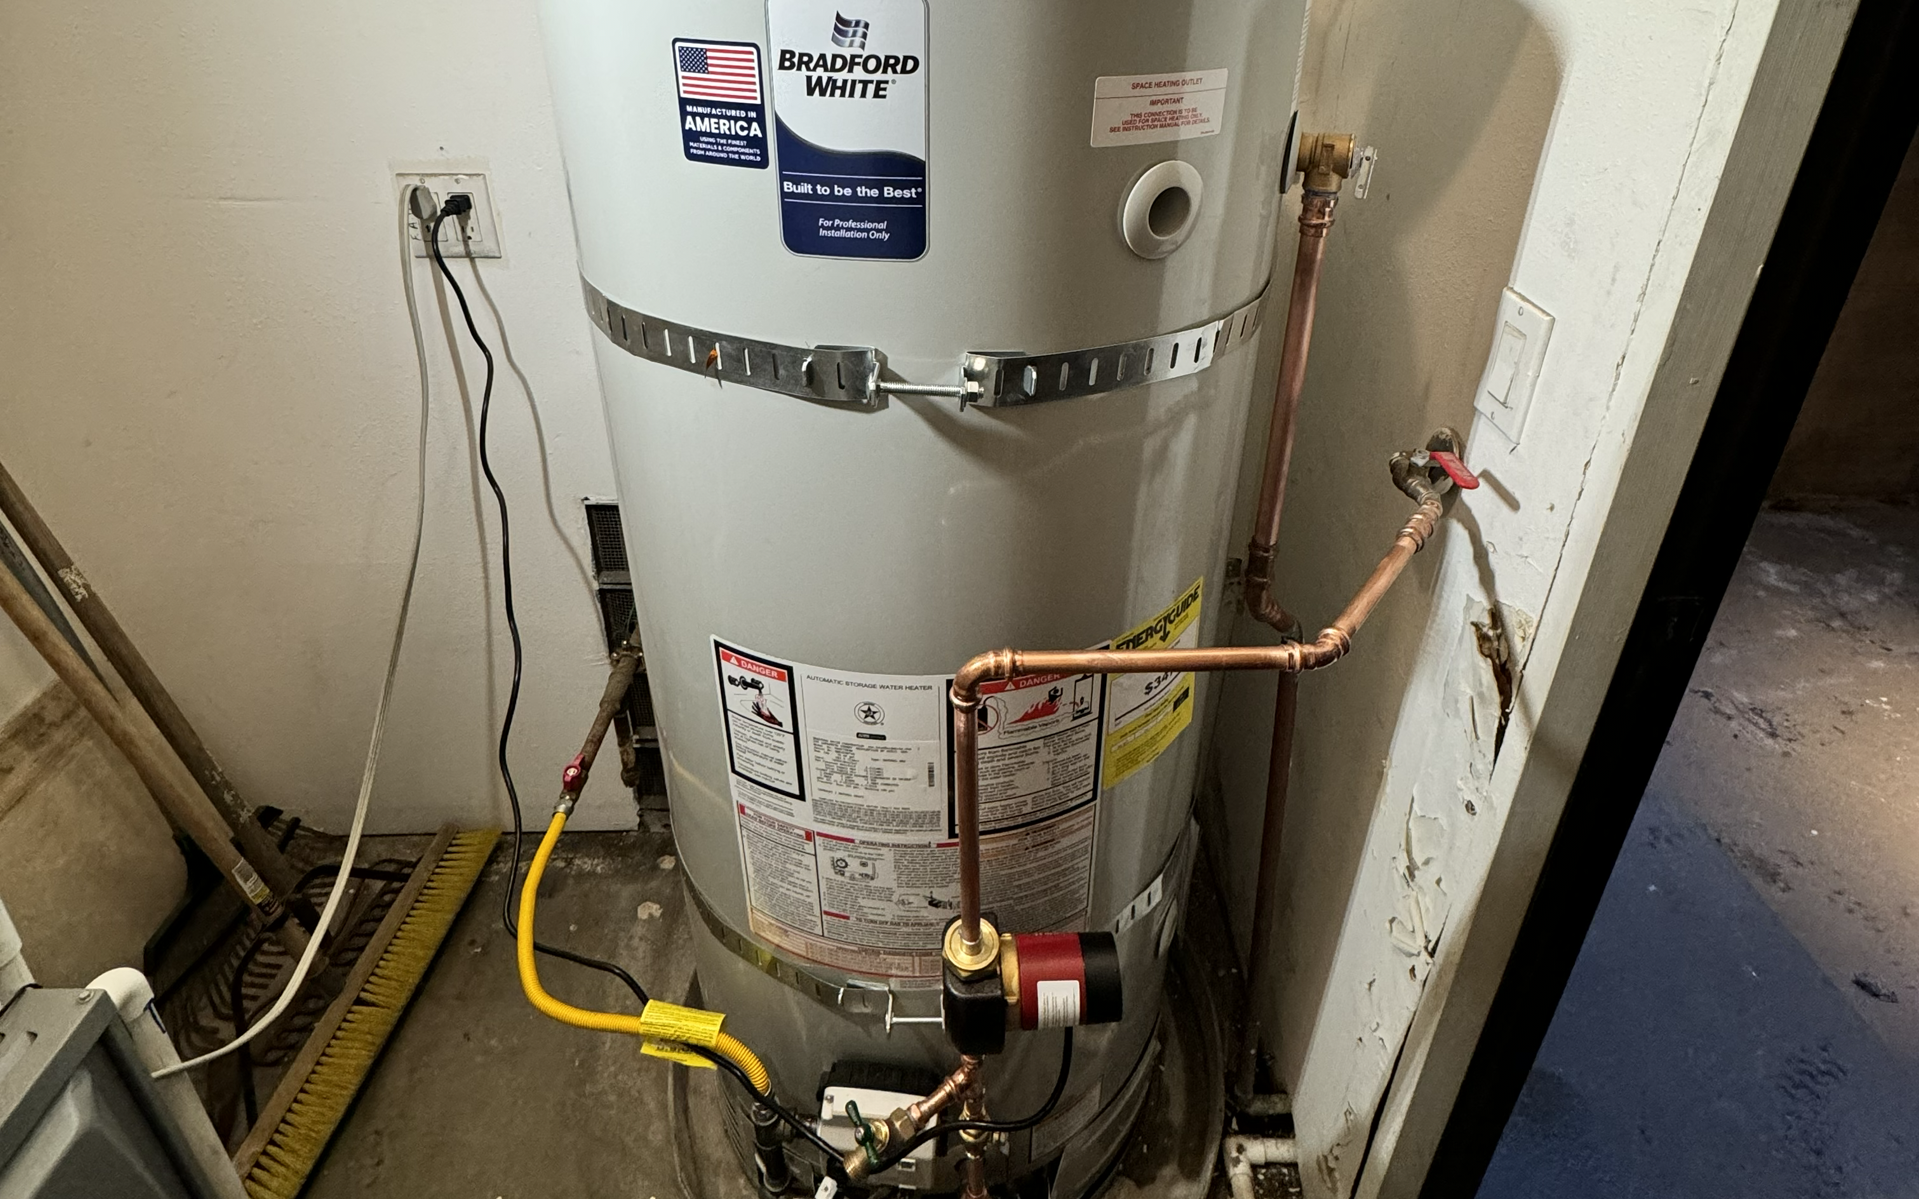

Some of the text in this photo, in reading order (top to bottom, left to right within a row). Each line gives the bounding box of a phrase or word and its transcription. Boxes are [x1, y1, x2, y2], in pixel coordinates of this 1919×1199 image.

[777, 49, 920, 75] BRADFORD
[1131, 78, 1203, 90] SPACE HEATING OUTLET
[1149, 97, 1184, 106] IMPORTANT
[686, 105, 746, 118] MANUFACTURED
[1143, 109, 1177, 118] CONNECTION
[685, 115, 762, 137] AMERICA
[1122, 123, 1158, 132] INSTRUCTION
[1158, 121, 1180, 129] MANUAL
[689, 142, 717, 150] MATERIALS
[723, 146, 760, 154] COMPONENTS
[783, 181, 813, 194] Built
[816, 184, 830, 195] to
[834, 185, 852, 196] be
[856, 186, 879, 197] the
[819, 218, 887, 229] For Professional
[819, 228, 890, 241] Installation Only
[740, 660, 778, 679] DANGER
[806, 674, 843, 685] AUTOMATIC
[845, 681, 877, 689] STORAGE
[1020, 674, 1060, 687] DANGER
